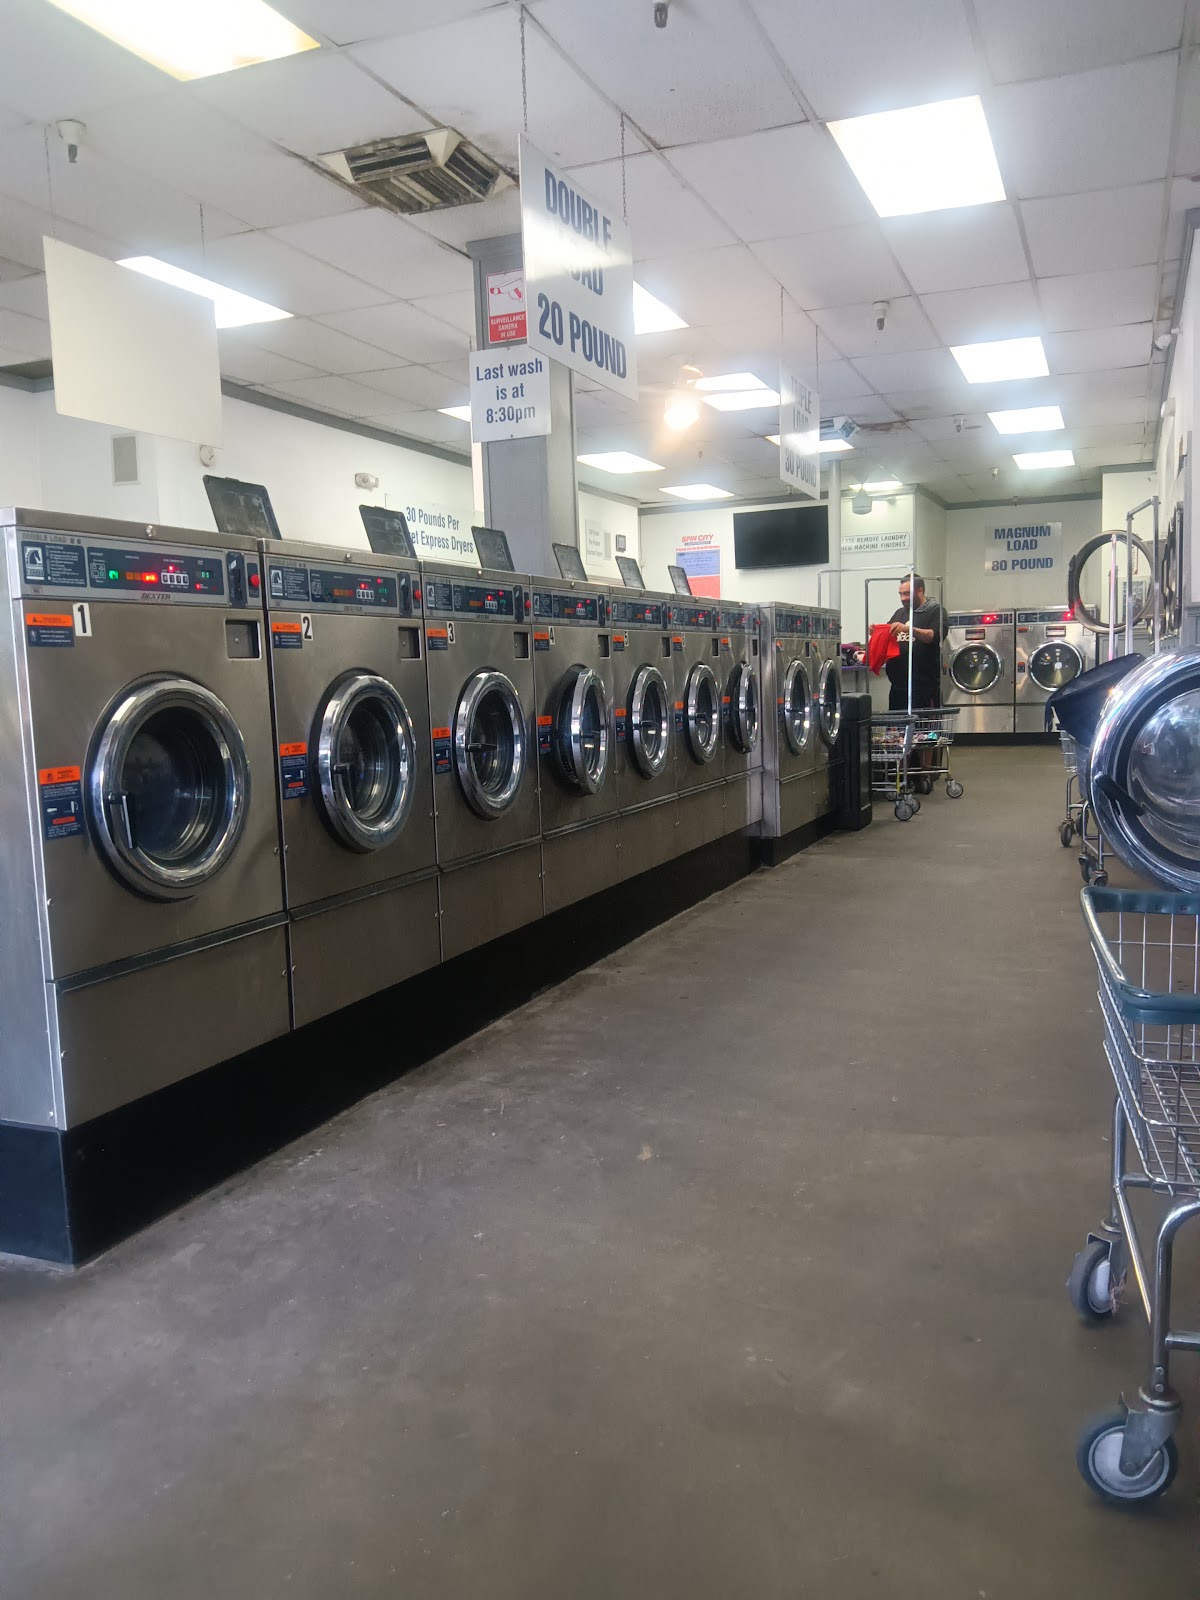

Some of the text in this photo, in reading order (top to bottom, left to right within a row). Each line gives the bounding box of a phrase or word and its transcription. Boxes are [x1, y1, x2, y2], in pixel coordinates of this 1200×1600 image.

[545, 167, 612, 252] DOUBLE
[490, 313, 525, 325] SURVEILLANCE
[497, 322, 518, 331] CAMERA
[537, 292, 627, 379] 20 POUND
[476, 357, 543, 382] Last wash
[496, 384, 525, 401] is at
[486, 405, 536, 424] 8:30pm
[796, 453, 817, 488] POUND
[406, 506, 460, 531] 30 Pounds Per
[681, 535, 697, 543] SPIN
[880, 533, 907, 542] LAUNDRY
[994, 525, 1051, 540] MAGNUM
[420, 531, 450, 550] Express
[451, 536, 474, 554] Dryers
[854, 543, 879, 551] MACHINE
[880, 541, 907, 549] FINISHES
[1007, 539, 1038, 551] LOAD
[991, 557, 1054, 572] 80 POUND
[141, 592, 171, 600] DEXTER
[77, 604, 88, 634] 1
[302, 615, 313, 640] 2
[447, 622, 455, 643] 3
